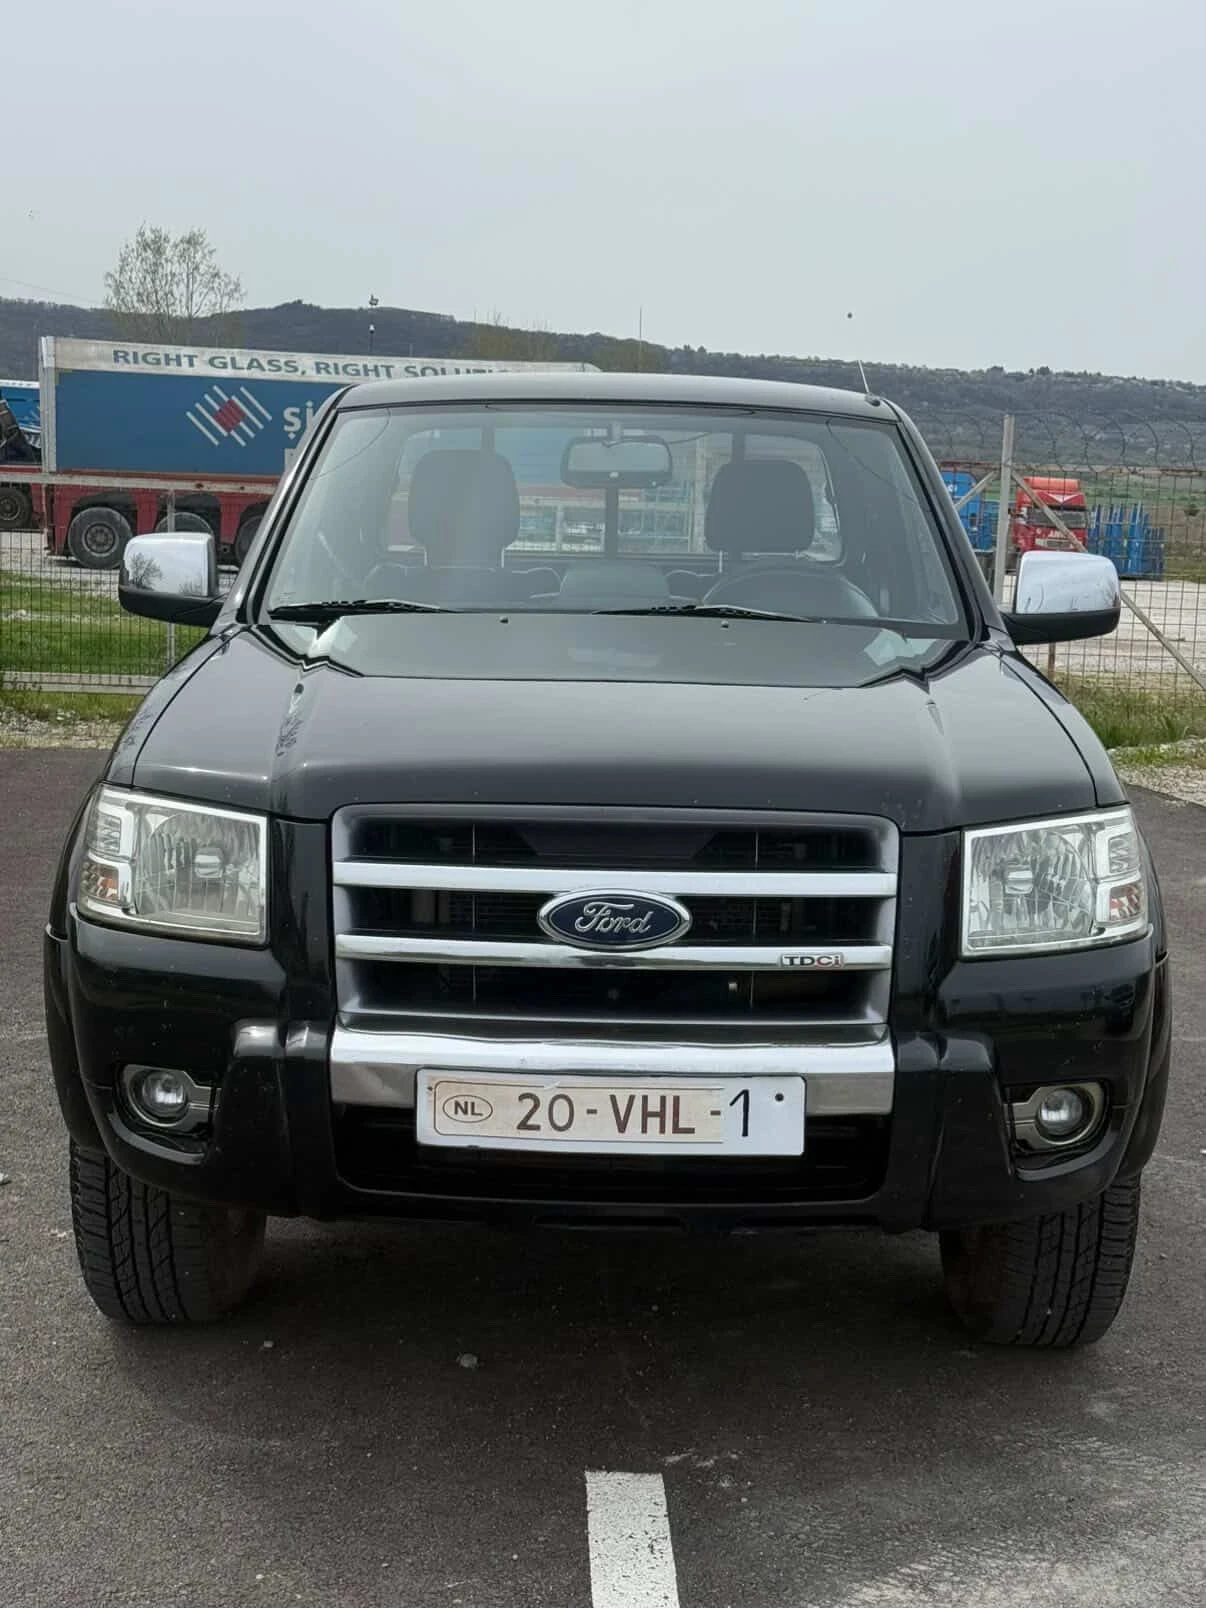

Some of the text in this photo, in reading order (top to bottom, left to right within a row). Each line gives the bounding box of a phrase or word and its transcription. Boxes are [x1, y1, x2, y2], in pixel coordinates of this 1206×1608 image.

[112, 349, 198, 368] RIGHT
[207, 355, 307, 375] GLASS,
[314, 361, 395, 379] RIGHT
[283, 400, 314, 440] Şi
[574, 901, 654, 933] Ford
[783, 955, 841, 968] TDCi
[452, 1100, 484, 1117] NL
